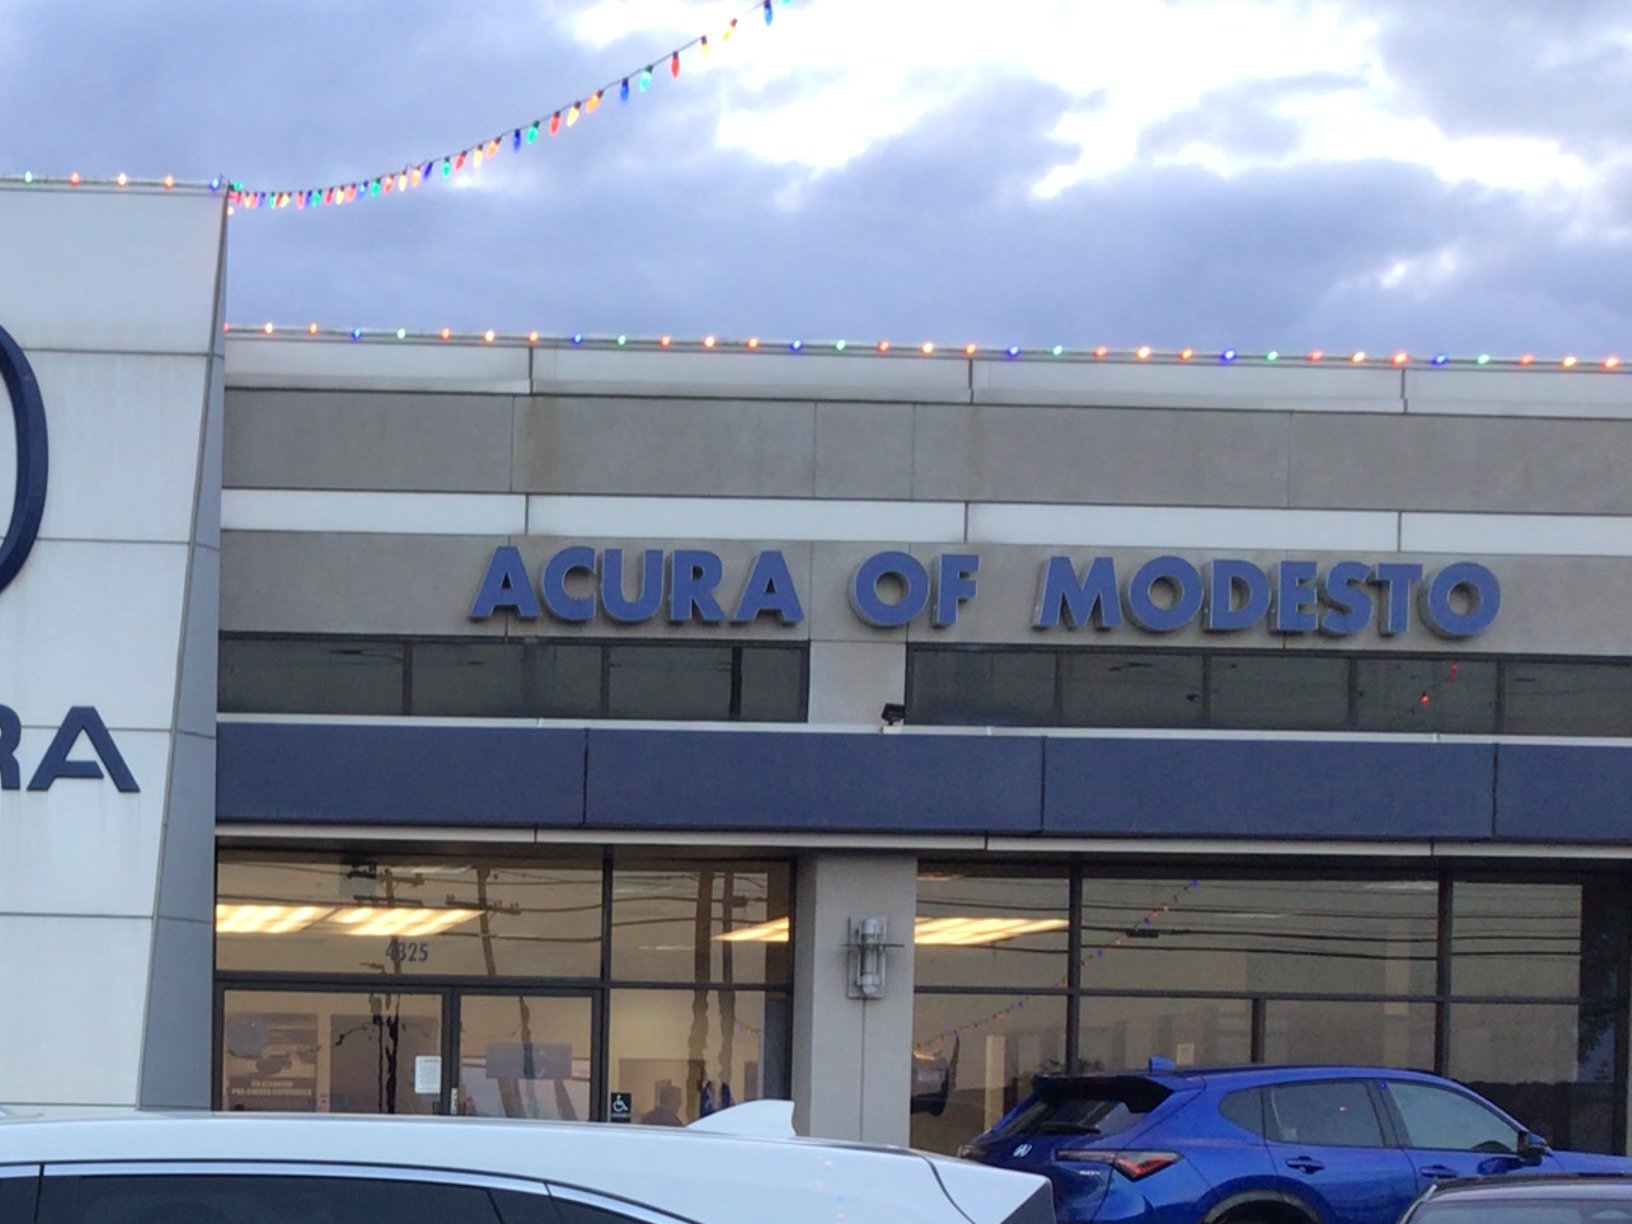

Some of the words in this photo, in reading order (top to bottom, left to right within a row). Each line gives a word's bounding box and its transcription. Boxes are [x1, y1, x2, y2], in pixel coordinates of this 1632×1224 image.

[470, 544, 805, 627] ACURA
[848, 549, 982, 630] OF
[1031, 555, 1502, 639] MODESTO
